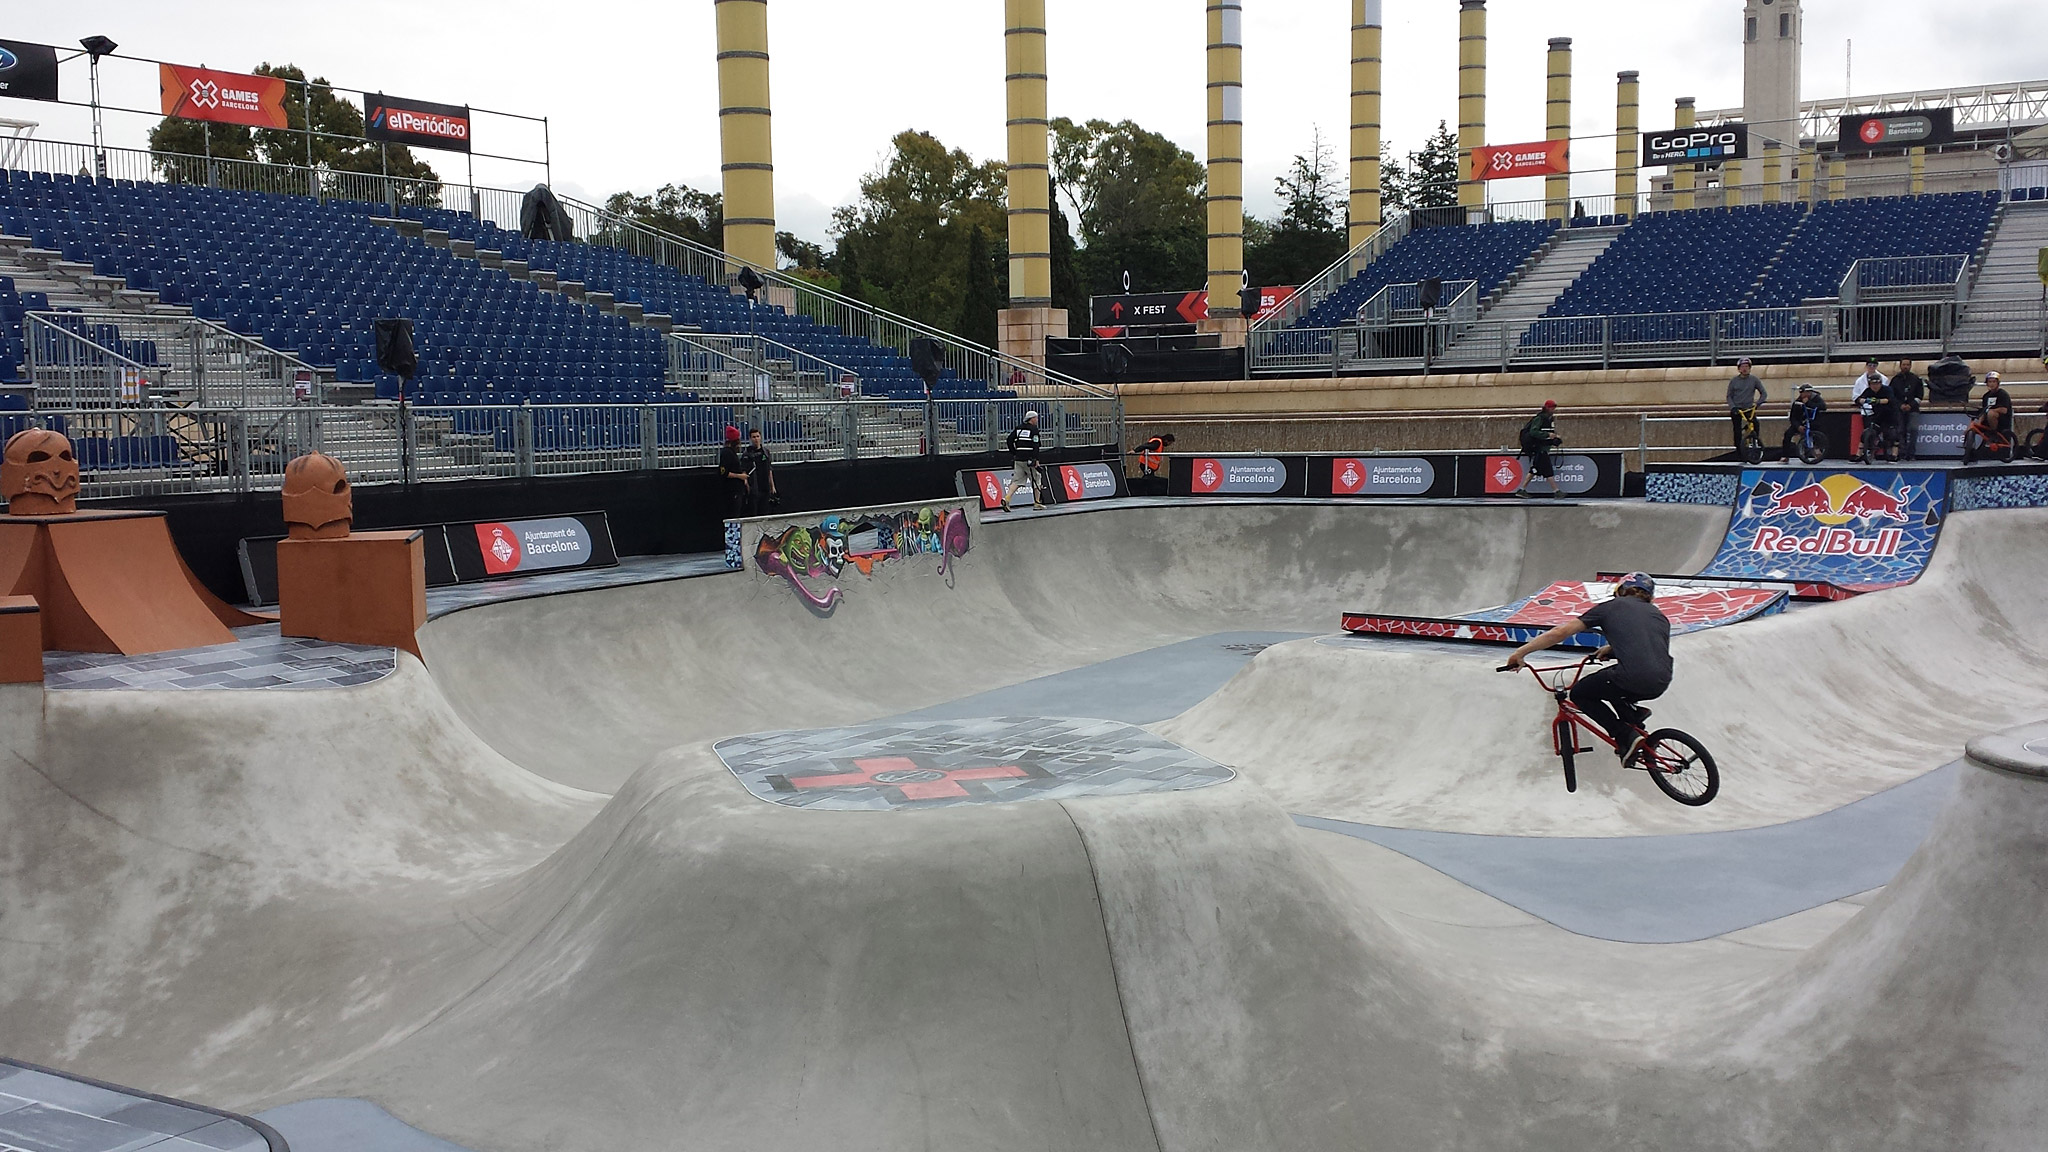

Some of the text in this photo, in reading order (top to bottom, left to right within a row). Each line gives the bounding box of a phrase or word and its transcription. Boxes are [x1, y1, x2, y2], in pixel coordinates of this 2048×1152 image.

[221, 88, 259, 103] GAMES
[221, 100, 259, 111] BARCELONA
[1888, 127, 1924, 135] Barcelona
[1651, 132, 1737, 150] GoPro
[1515, 151, 1547, 162] GAMES
[1133, 305, 1167, 315] X FEST
[1918, 423, 1968, 431] ntament de
[1229, 465, 1276, 474] Ajuntament de
[1372, 466, 1412, 475] Ajuntament
[1085, 478, 1111, 488] Barcelona
[1229, 474, 1275, 483] Barcelona
[1372, 474, 1422, 484] Barcelona
[524, 527, 576, 542] Ajuntament de
[526, 540, 580, 555] Barcelona
